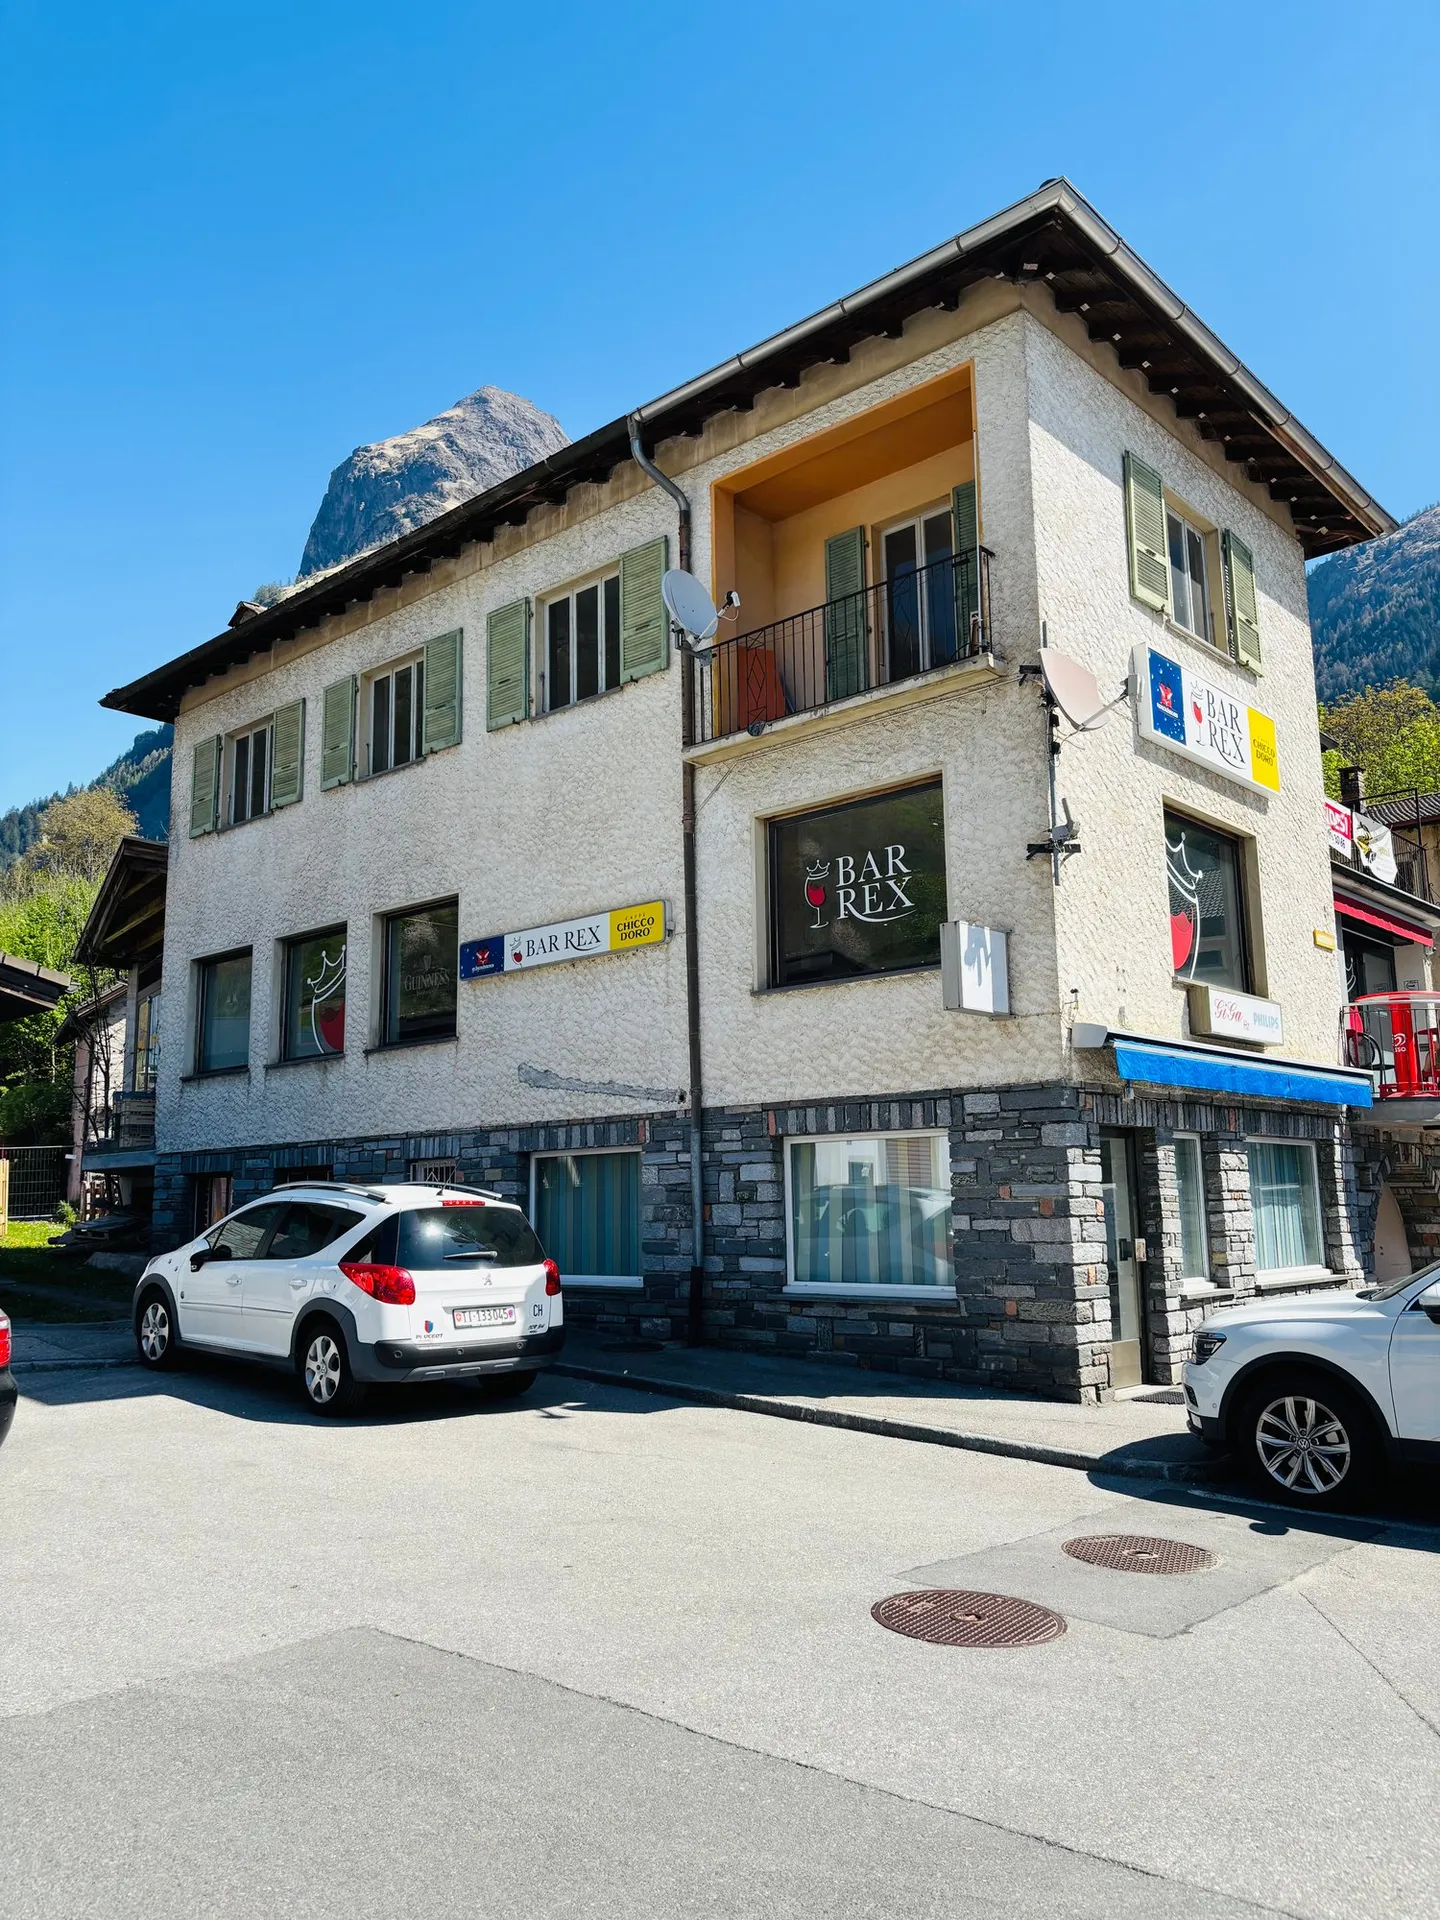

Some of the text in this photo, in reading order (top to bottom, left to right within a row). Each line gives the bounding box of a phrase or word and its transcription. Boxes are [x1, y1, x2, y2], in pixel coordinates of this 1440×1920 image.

[1205, 688, 1242, 735] BAR
[1207, 718, 1247, 770] REX
[1253, 738, 1275, 758] CHICCO
[835, 844, 912, 888] BAR
[836, 875, 918, 923] REX
[616, 916, 655, 932] CHICCO
[620, 927, 651, 941] D'ORO
[525, 925, 602, 957] BAR REX
[403, 972, 450, 992] GUINNESS
[1253, 1011, 1279, 1030] PHILIPS
[533, 1304, 543, 1317] CH
